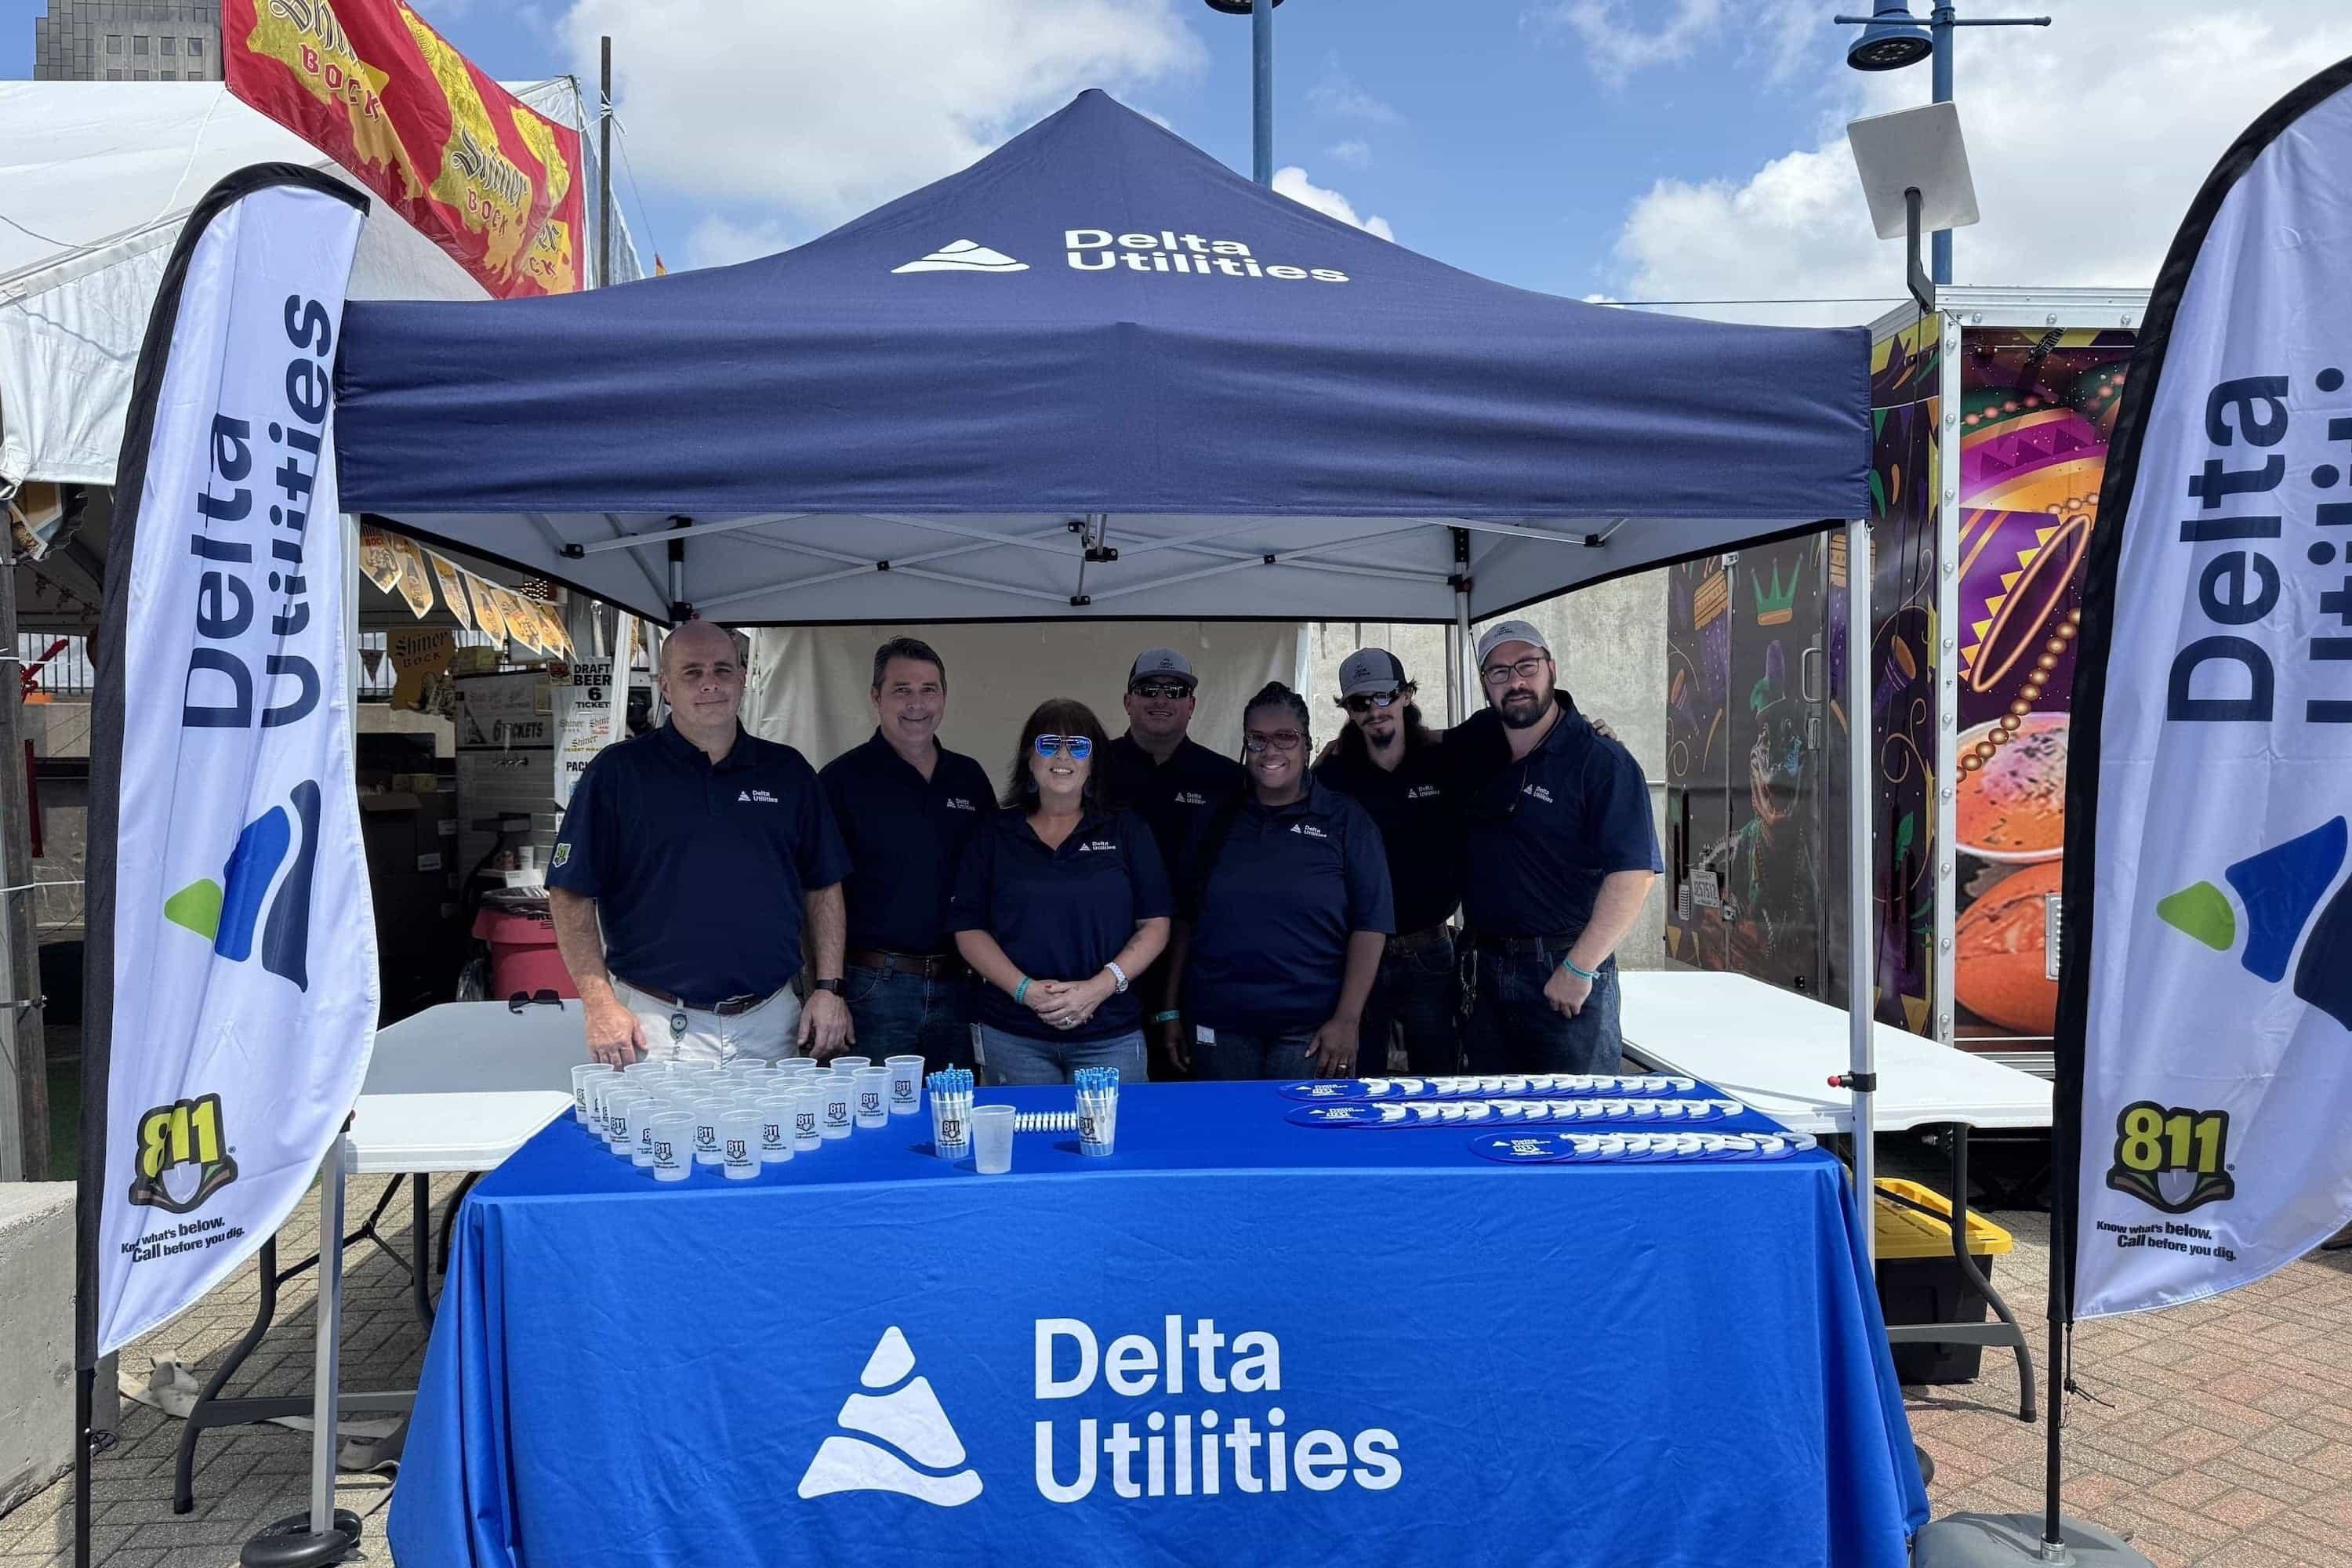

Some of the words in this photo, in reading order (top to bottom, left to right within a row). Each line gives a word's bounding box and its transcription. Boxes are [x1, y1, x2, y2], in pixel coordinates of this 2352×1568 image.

[299, 43, 382, 122] BOCK
[466, 187, 509, 237] BOCK
[1065, 228, 1251, 257] Delta
[1067, 251, 1350, 283] Utilities
[2167, 375, 2289, 722] Delta
[182, 412, 253, 728] Delta
[394, 630, 448, 657] Shiner
[573, 675, 612, 686] BEER
[574, 663, 611, 674] DRAFT
[588, 687, 602, 701] 6
[502, 720, 543, 740] TCKETS
[862, 1092, 879, 1106] 811
[895, 1080, 911, 1094] 811
[797, 1113, 815, 1127] 811
[828, 1102, 846, 1116] 811
[141, 1098, 222, 1178] 811
[697, 1126, 714, 1139] 811
[2119, 1105, 2223, 1174] 811
[654, 1142, 671, 1156] 811
[728, 1140, 745, 1154] 811
[141, 1229, 176, 1246] what's
[178, 1217, 225, 1236] below.
[2096, 1221, 2128, 1234] Know
[2129, 1224, 2163, 1234] what's
[2165, 1221, 2212, 1240] below.
[132, 1243, 161, 1263] Call
[163, 1239, 203, 1256] before
[205, 1233, 225, 1249] you
[227, 1226, 245, 1240] dig.
[2118, 1234, 2146, 1248] Call
[2147, 1236, 2187, 1253] before
[2189, 1243, 2211, 1256] you
[2212, 1246, 2237, 1261] dig.
[1034, 1313, 1282, 1400] Delta
[1034, 1406, 1403, 1504] Utilities
